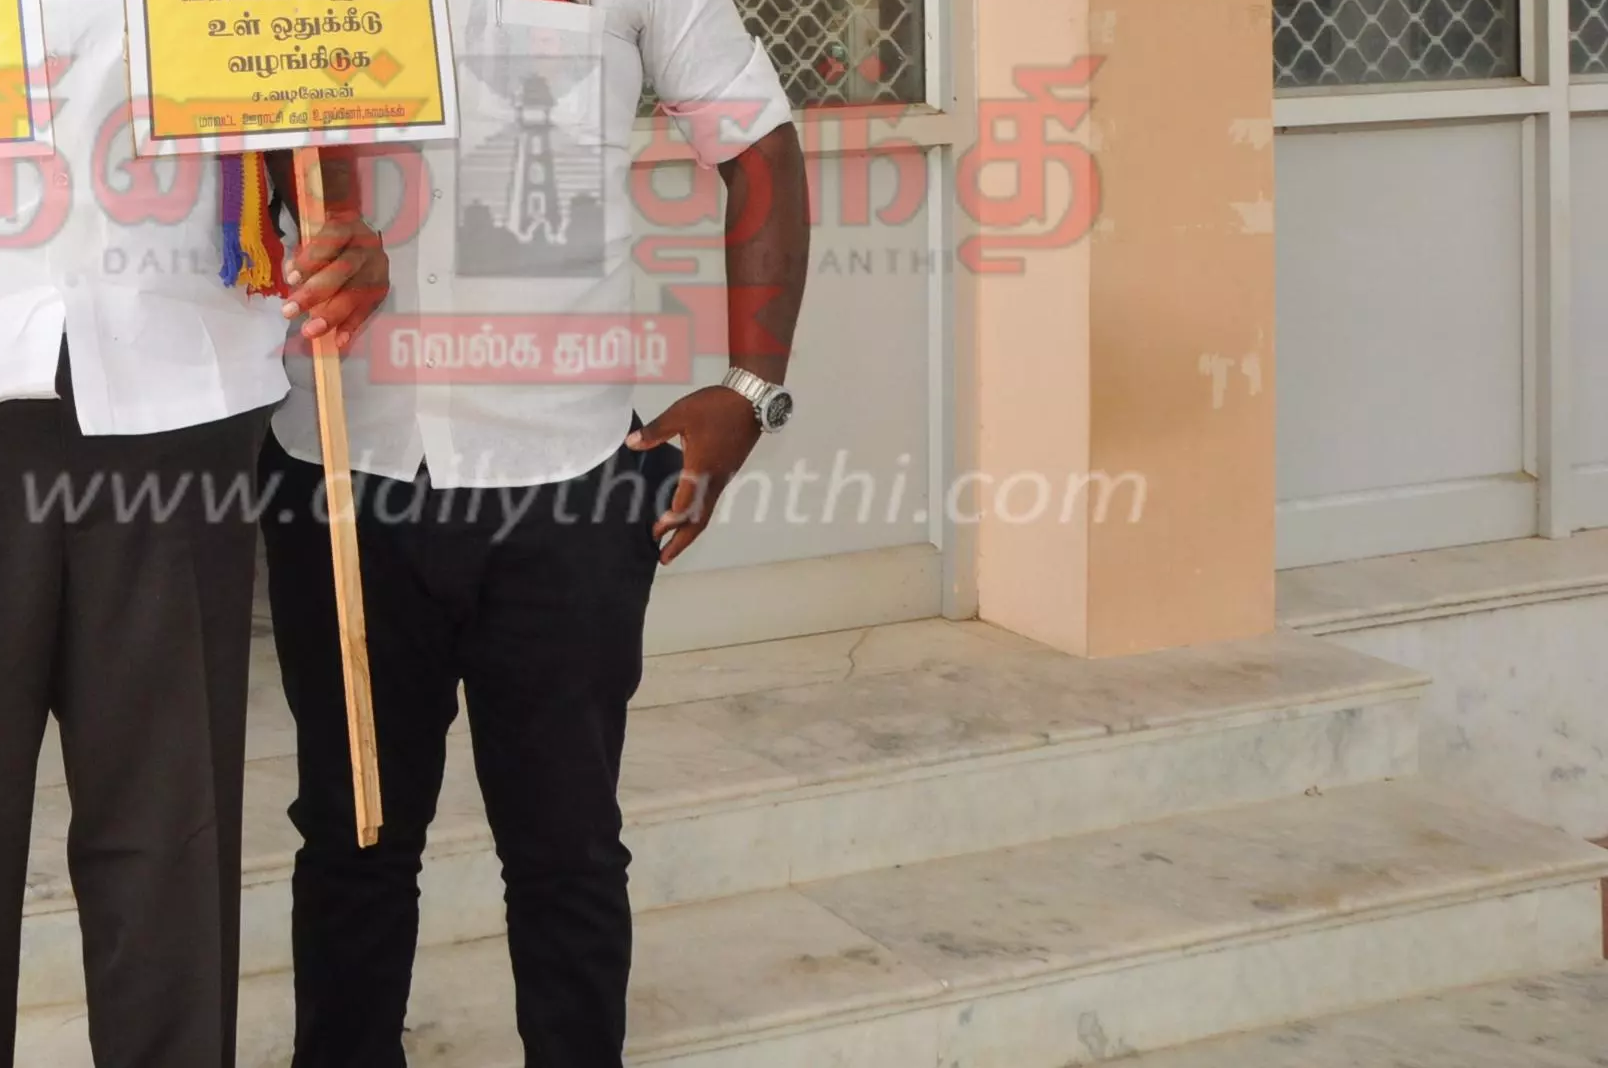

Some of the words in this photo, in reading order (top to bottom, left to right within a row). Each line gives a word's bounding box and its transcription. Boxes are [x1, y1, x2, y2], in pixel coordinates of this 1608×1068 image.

[208, 12, 260, 37] உள்
[271, 7, 383, 40] ஒதுக்கீடு
[228, 46, 371, 78] வழங்கிடுக
